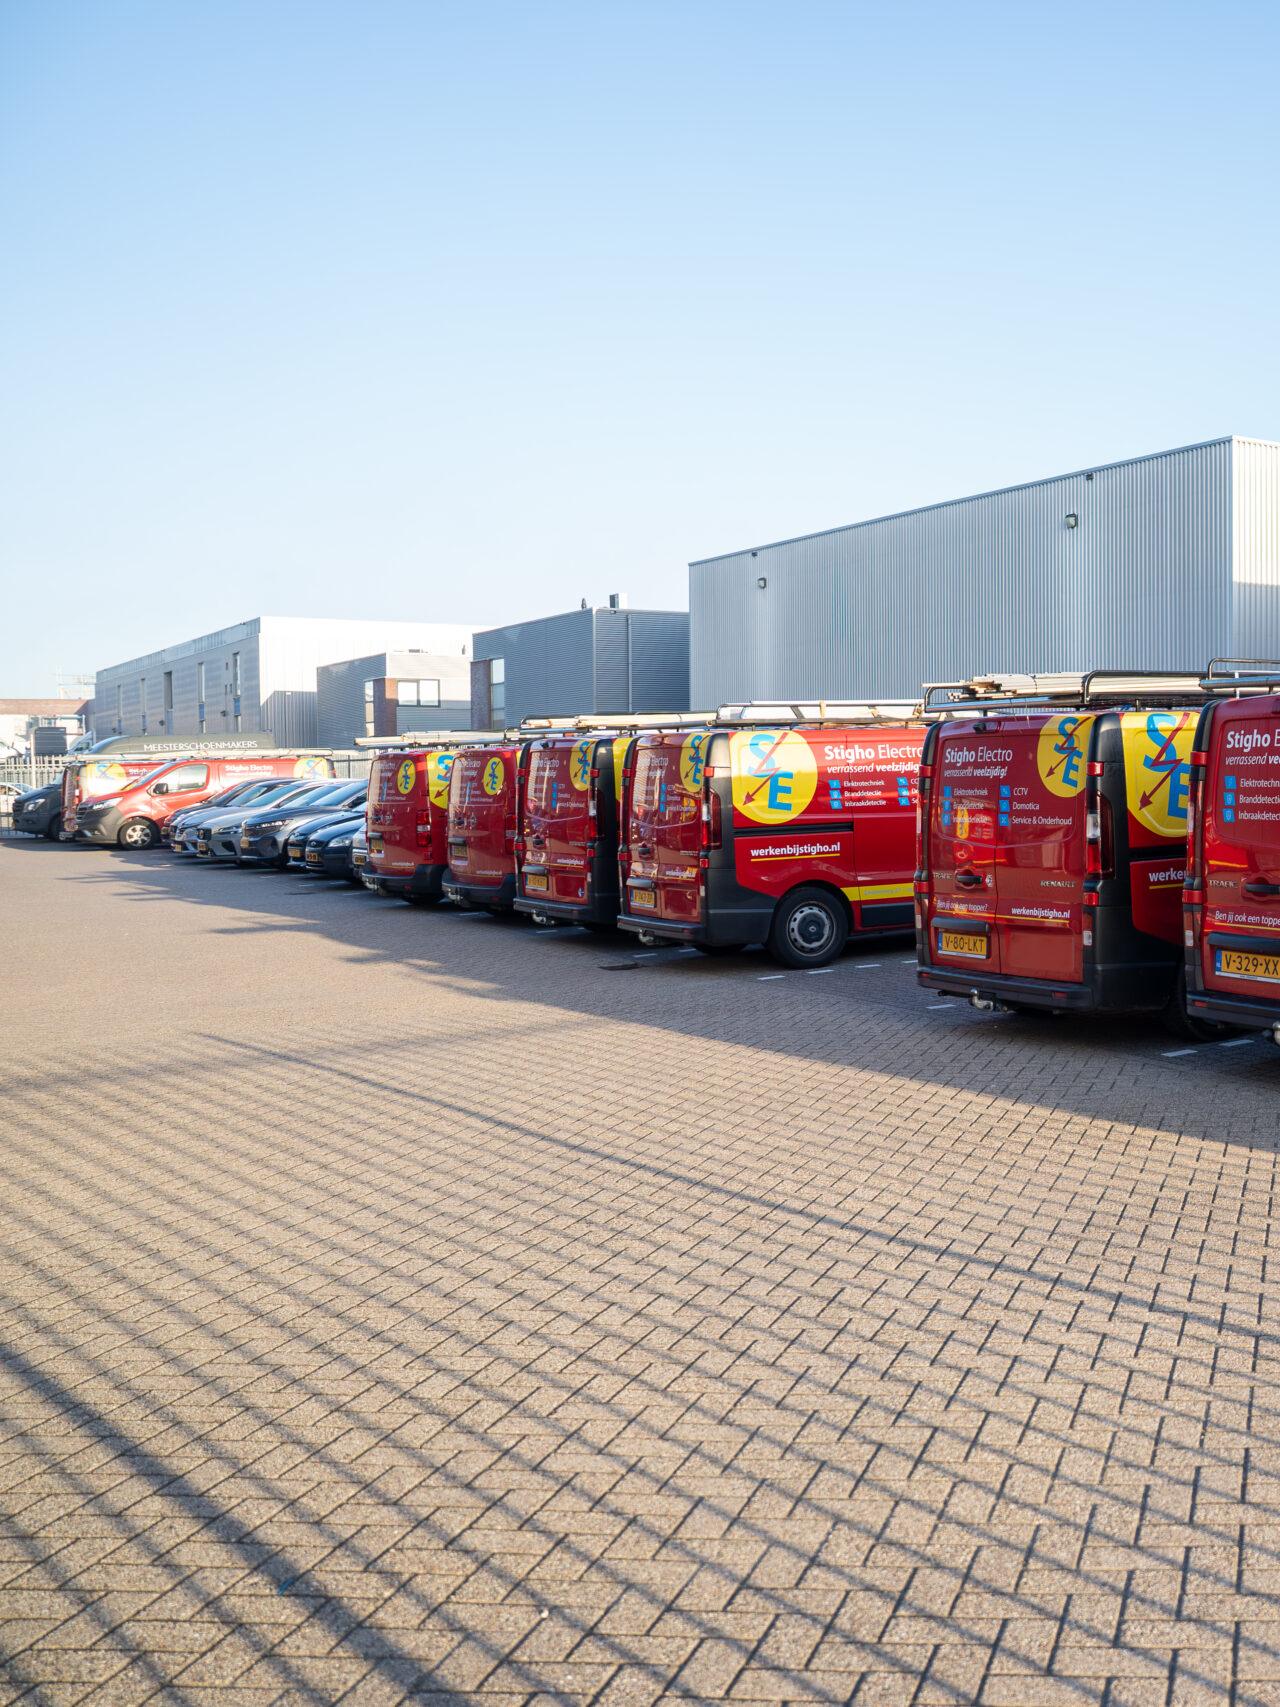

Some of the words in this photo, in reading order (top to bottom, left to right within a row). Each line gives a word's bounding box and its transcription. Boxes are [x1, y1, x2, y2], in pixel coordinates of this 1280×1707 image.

[144, 740, 258, 751] MEESTERSCHOENMAKERS
[1226, 729, 1271, 752] Stigho
[824, 744, 875, 763] Stigho
[945, 747, 975, 766] Stigho
[977, 746, 1013, 762] Electro
[1225, 753, 1268, 766] verrassend
[827, 762, 874, 773] verrassend
[973, 766, 1008, 779] veelzijdig!
[843, 779, 885, 787] Elektrotechniek
[1013, 787, 1028, 796] CCTV
[845, 799, 887, 807] Inbraakdetectie
[1012, 802, 1040, 810] Domotica
[1012, 816, 1031, 825] Service
[1032, 816, 1038, 824] &
[1038, 816, 1073, 825] Onderhoud
[751, 842, 840, 857] werkenbijstigho.nl
[1011, 907, 1071, 919] werkenbijstigho.nl
[1215, 910, 1227, 920] Ben
[1234, 913, 1247, 922] ook
[1247, 915, 1260, 923] een
[945, 935, 984, 953] V-80-LKT
[1225, 954, 1279, 976] V-329-XX
